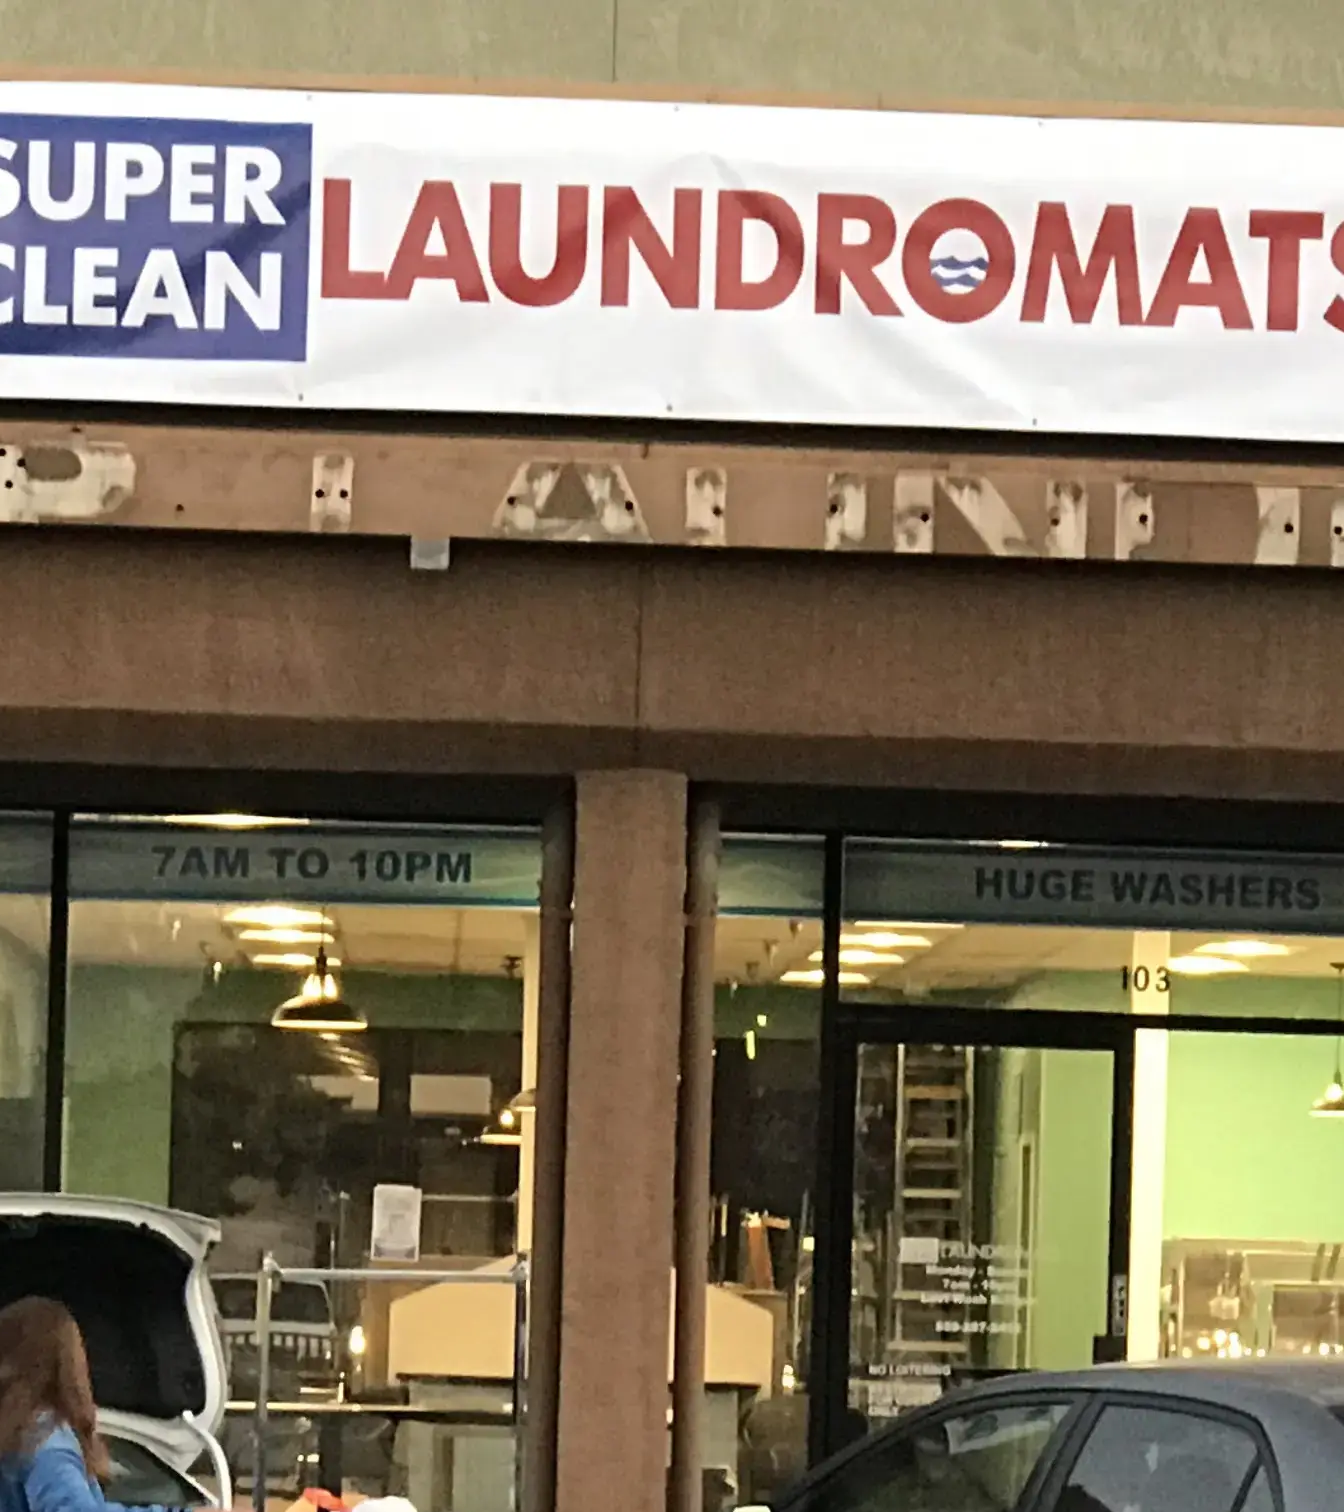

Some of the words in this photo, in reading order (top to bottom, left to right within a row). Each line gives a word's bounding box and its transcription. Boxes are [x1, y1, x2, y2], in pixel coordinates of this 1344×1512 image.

[151, 846, 250, 878] 7AM
[266, 846, 330, 880] TO
[349, 848, 472, 884] 10PM
[975, 867, 1096, 901] HUGE
[1111, 870, 1321, 911] WASHERS
[1120, 964, 1171, 993] 103
